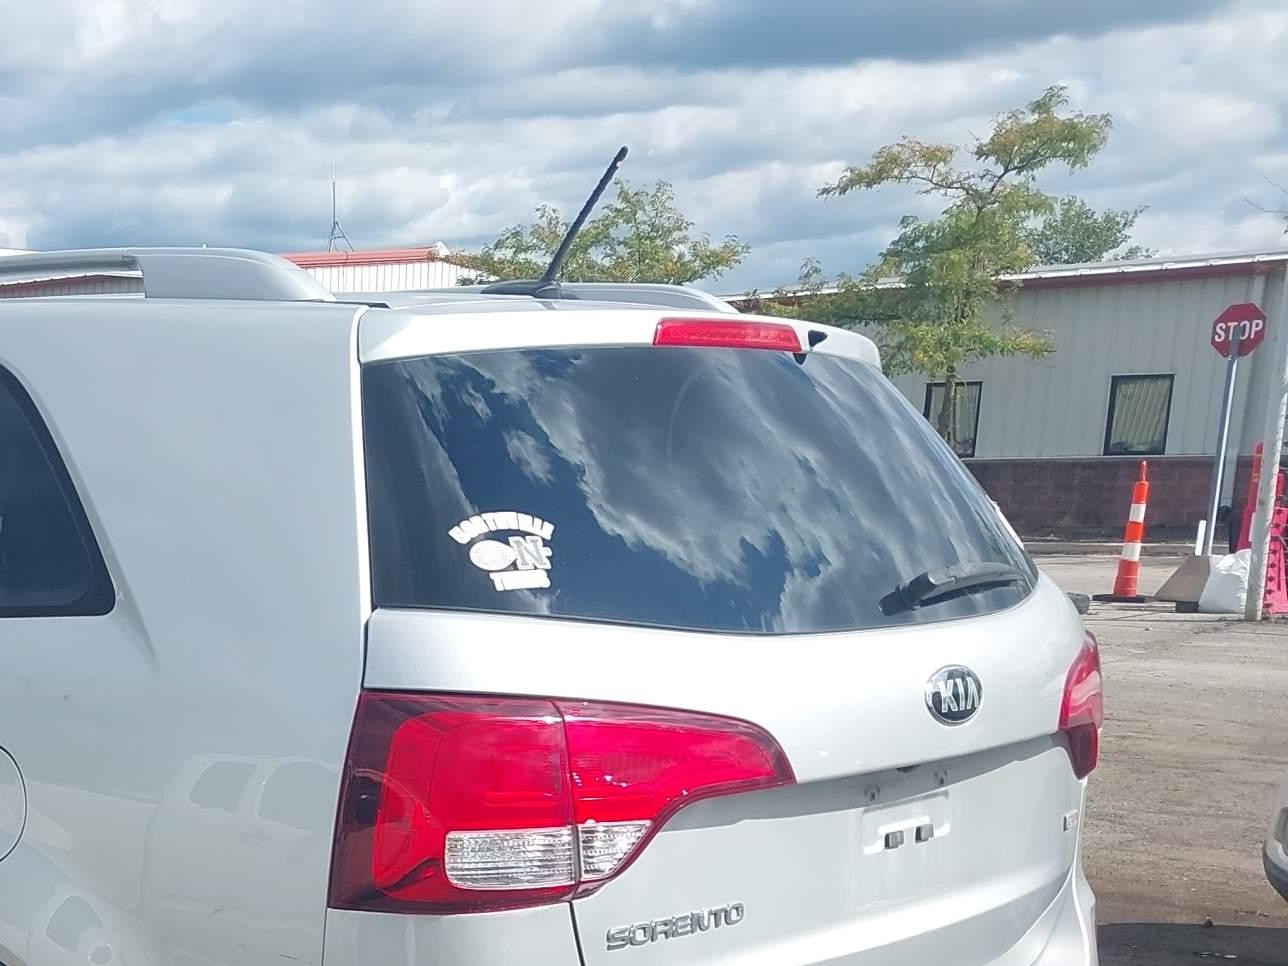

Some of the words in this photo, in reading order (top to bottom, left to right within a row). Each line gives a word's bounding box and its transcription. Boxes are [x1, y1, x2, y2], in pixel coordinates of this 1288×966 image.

[1214, 319, 1263, 342] STOP
[938, 677, 979, 713] KIA
[606, 902, 744, 951] SORENTO
